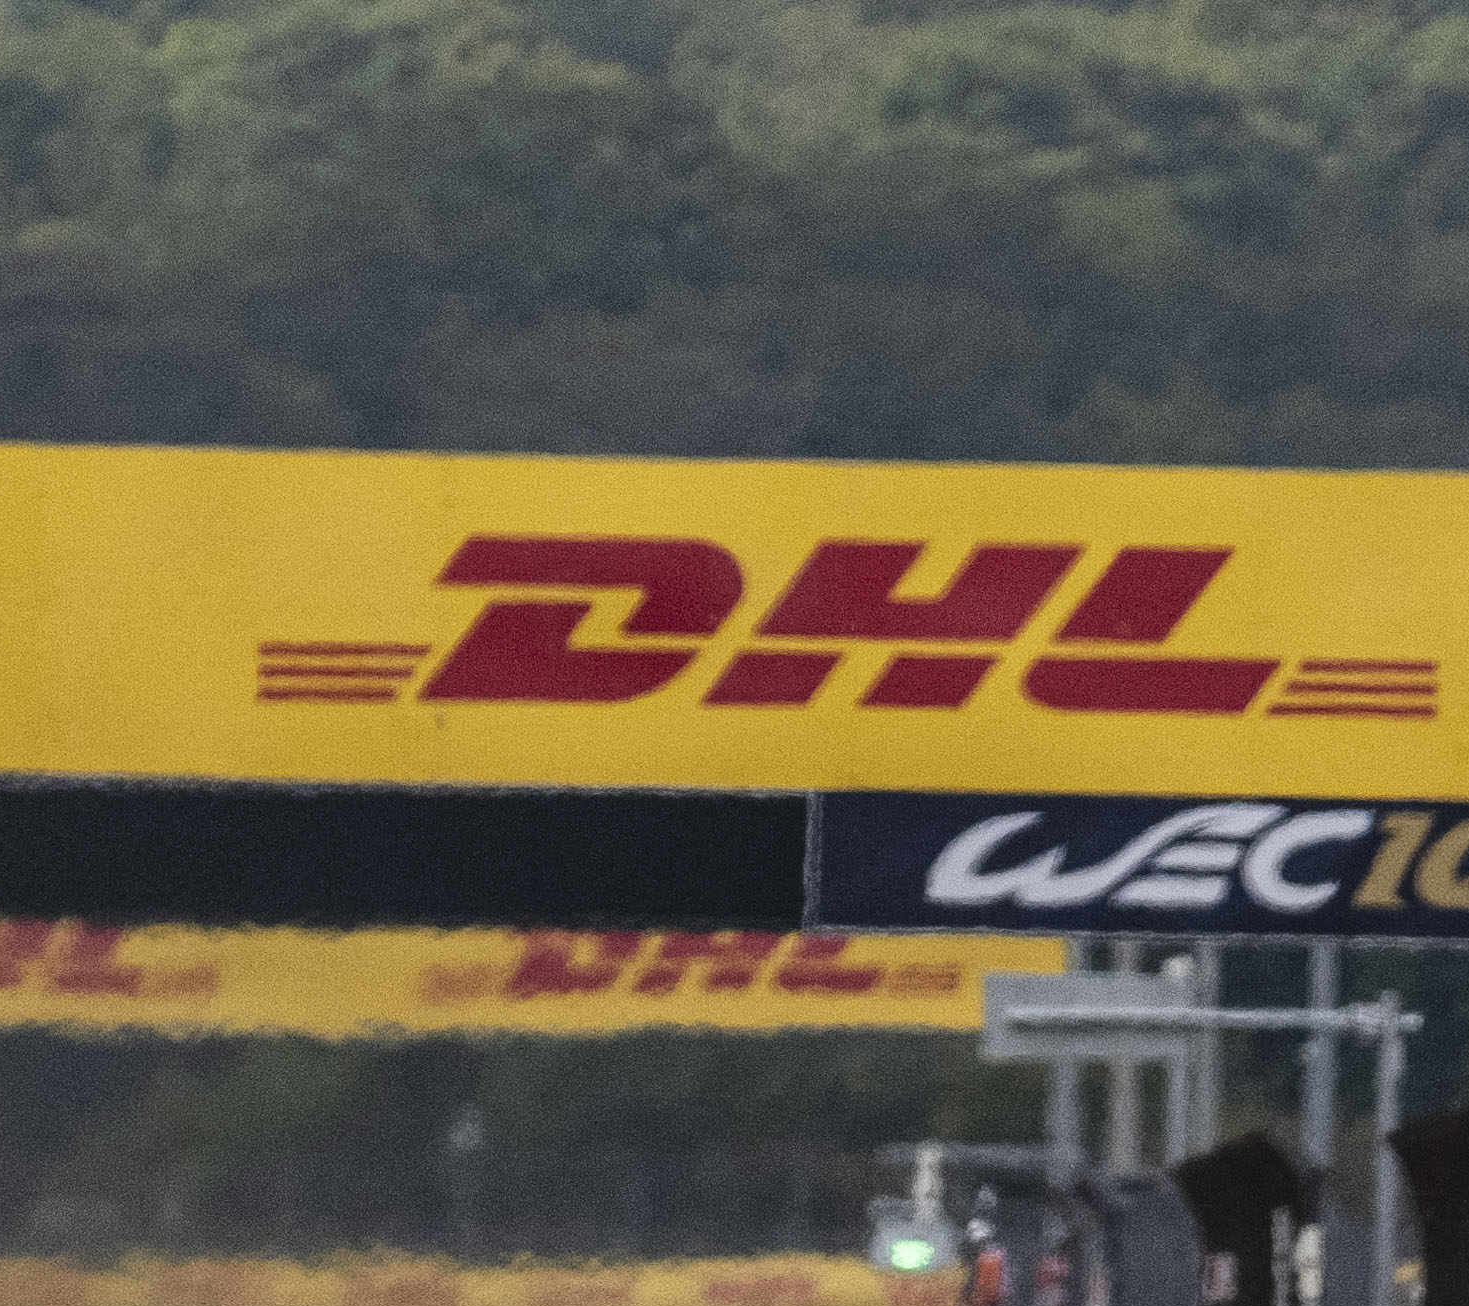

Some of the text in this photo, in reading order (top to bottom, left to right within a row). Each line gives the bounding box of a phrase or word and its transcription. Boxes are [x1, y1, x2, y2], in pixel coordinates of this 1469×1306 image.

[416, 534, 1282, 717] DHL
[924, 803, 1374, 914] WEC
[504, 929, 884, 996] DHL
